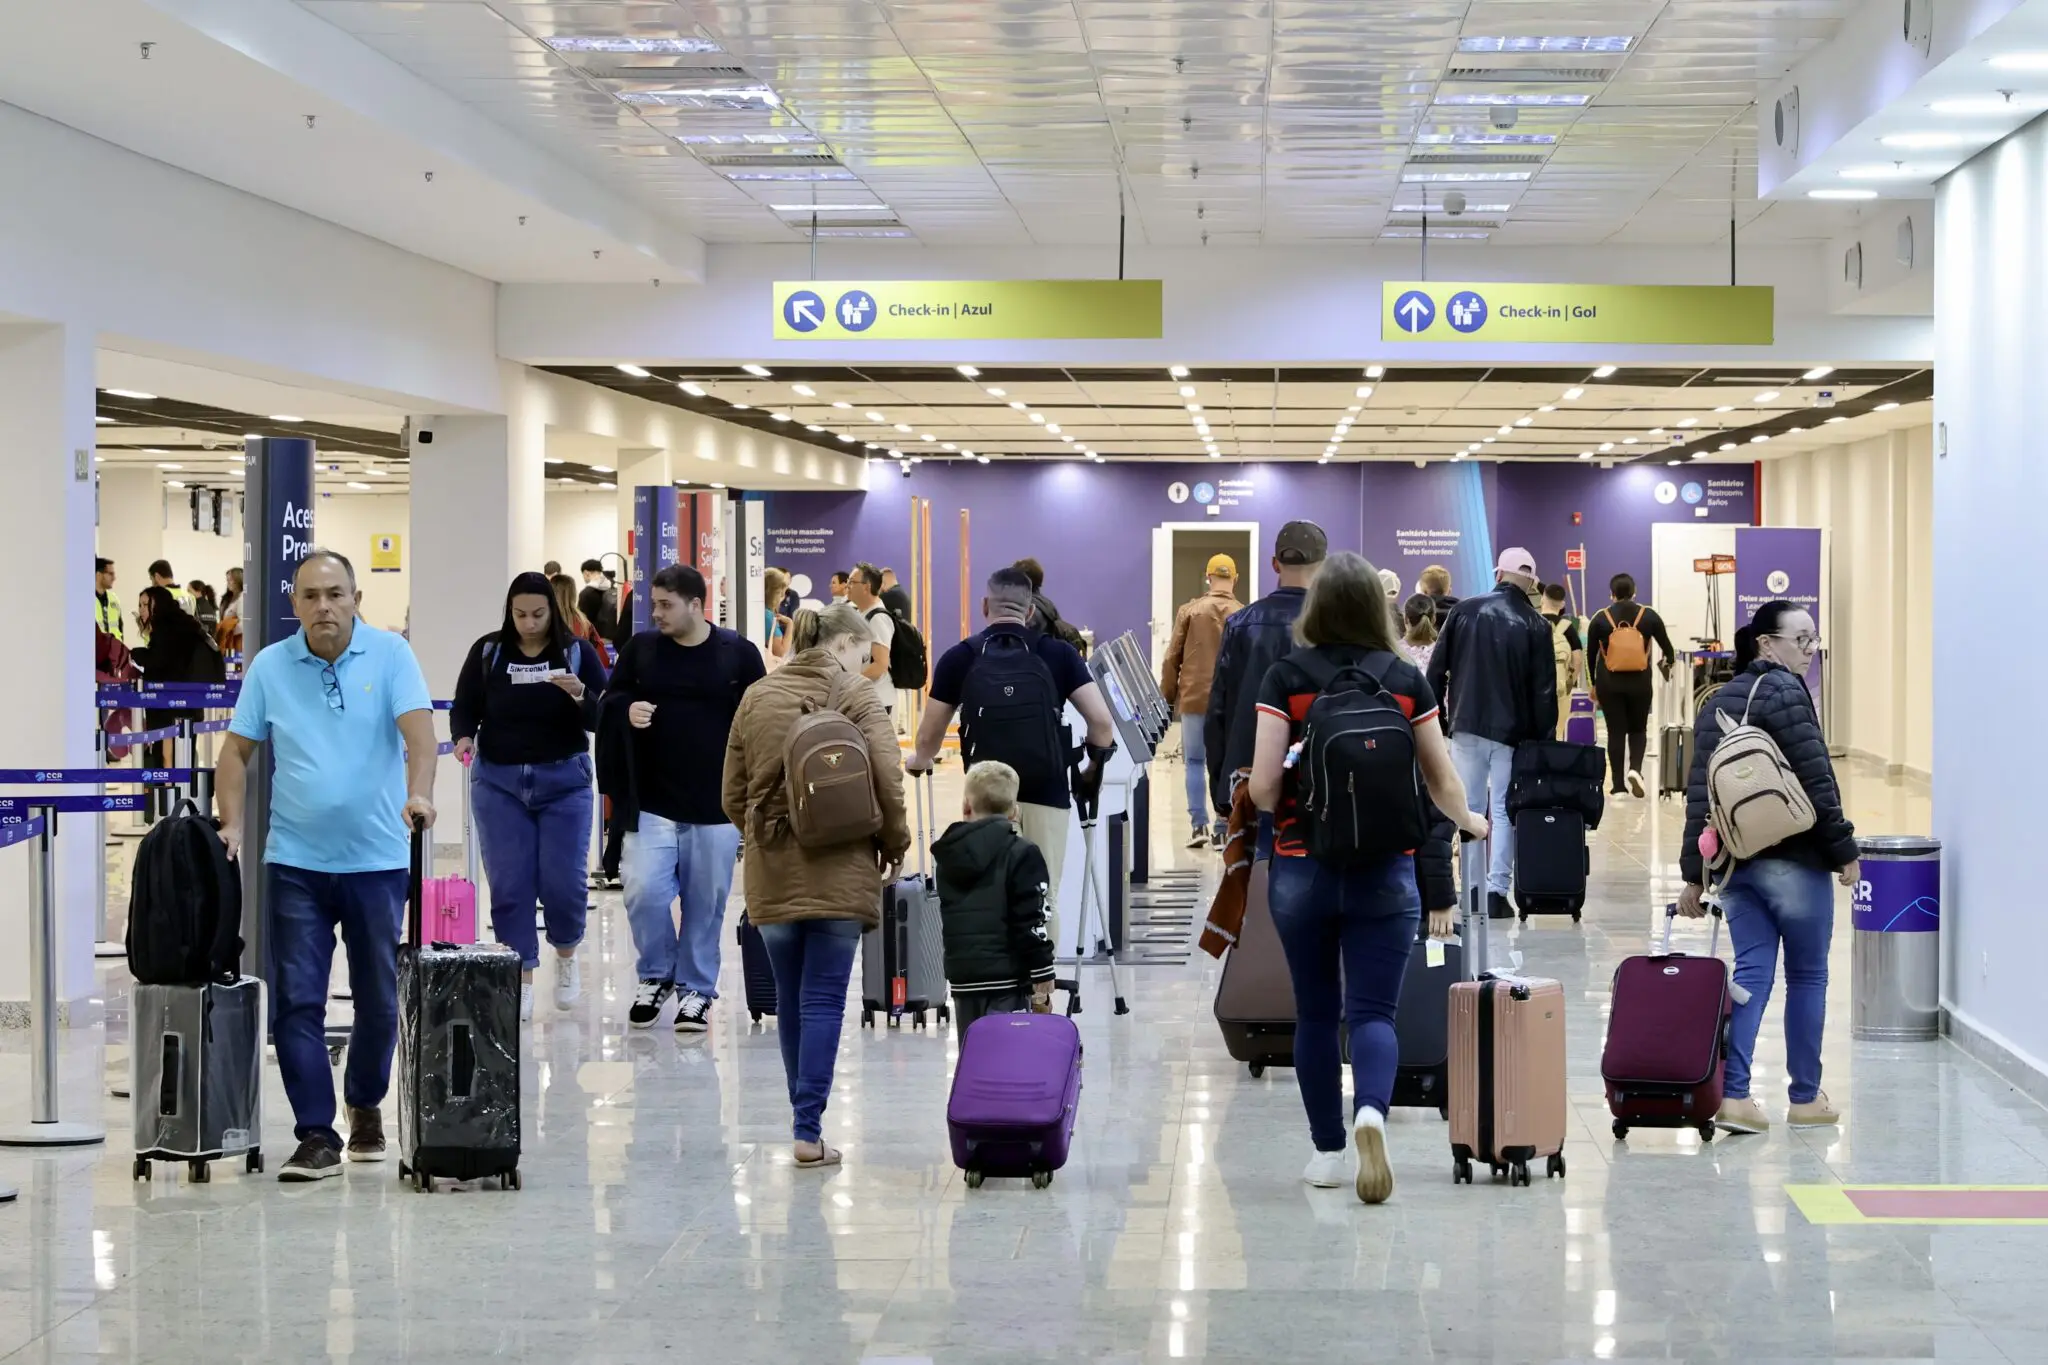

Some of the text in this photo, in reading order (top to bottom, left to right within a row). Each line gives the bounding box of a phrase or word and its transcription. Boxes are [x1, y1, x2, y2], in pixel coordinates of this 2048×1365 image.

[888, 303, 950, 316] Check-in
[961, 302, 993, 316] Azul
[1499, 305, 1561, 318] Check-in
[1572, 305, 1597, 318] Gol
[1707, 479, 1744, 487] Sanitários
[1707, 489, 1743, 497] Restrooms
[1707, 498, 1729, 506] Baños
[282, 501, 315, 529] Aces
[661, 522, 677, 537] Entr
[766, 528, 834, 536] Sanitário masculino
[1396, 529, 1461, 537] Sanitário feminino
[795, 537, 825, 545] restroom
[1397, 538, 1427, 546] Women's
[750, 536, 764, 557] Sa
[774, 545, 826, 554] Baño masculino
[1403, 547, 1454, 555] Baño femenino
[1788, 594, 1818, 602] carrinho
[2, 816, 22, 824] CCR
